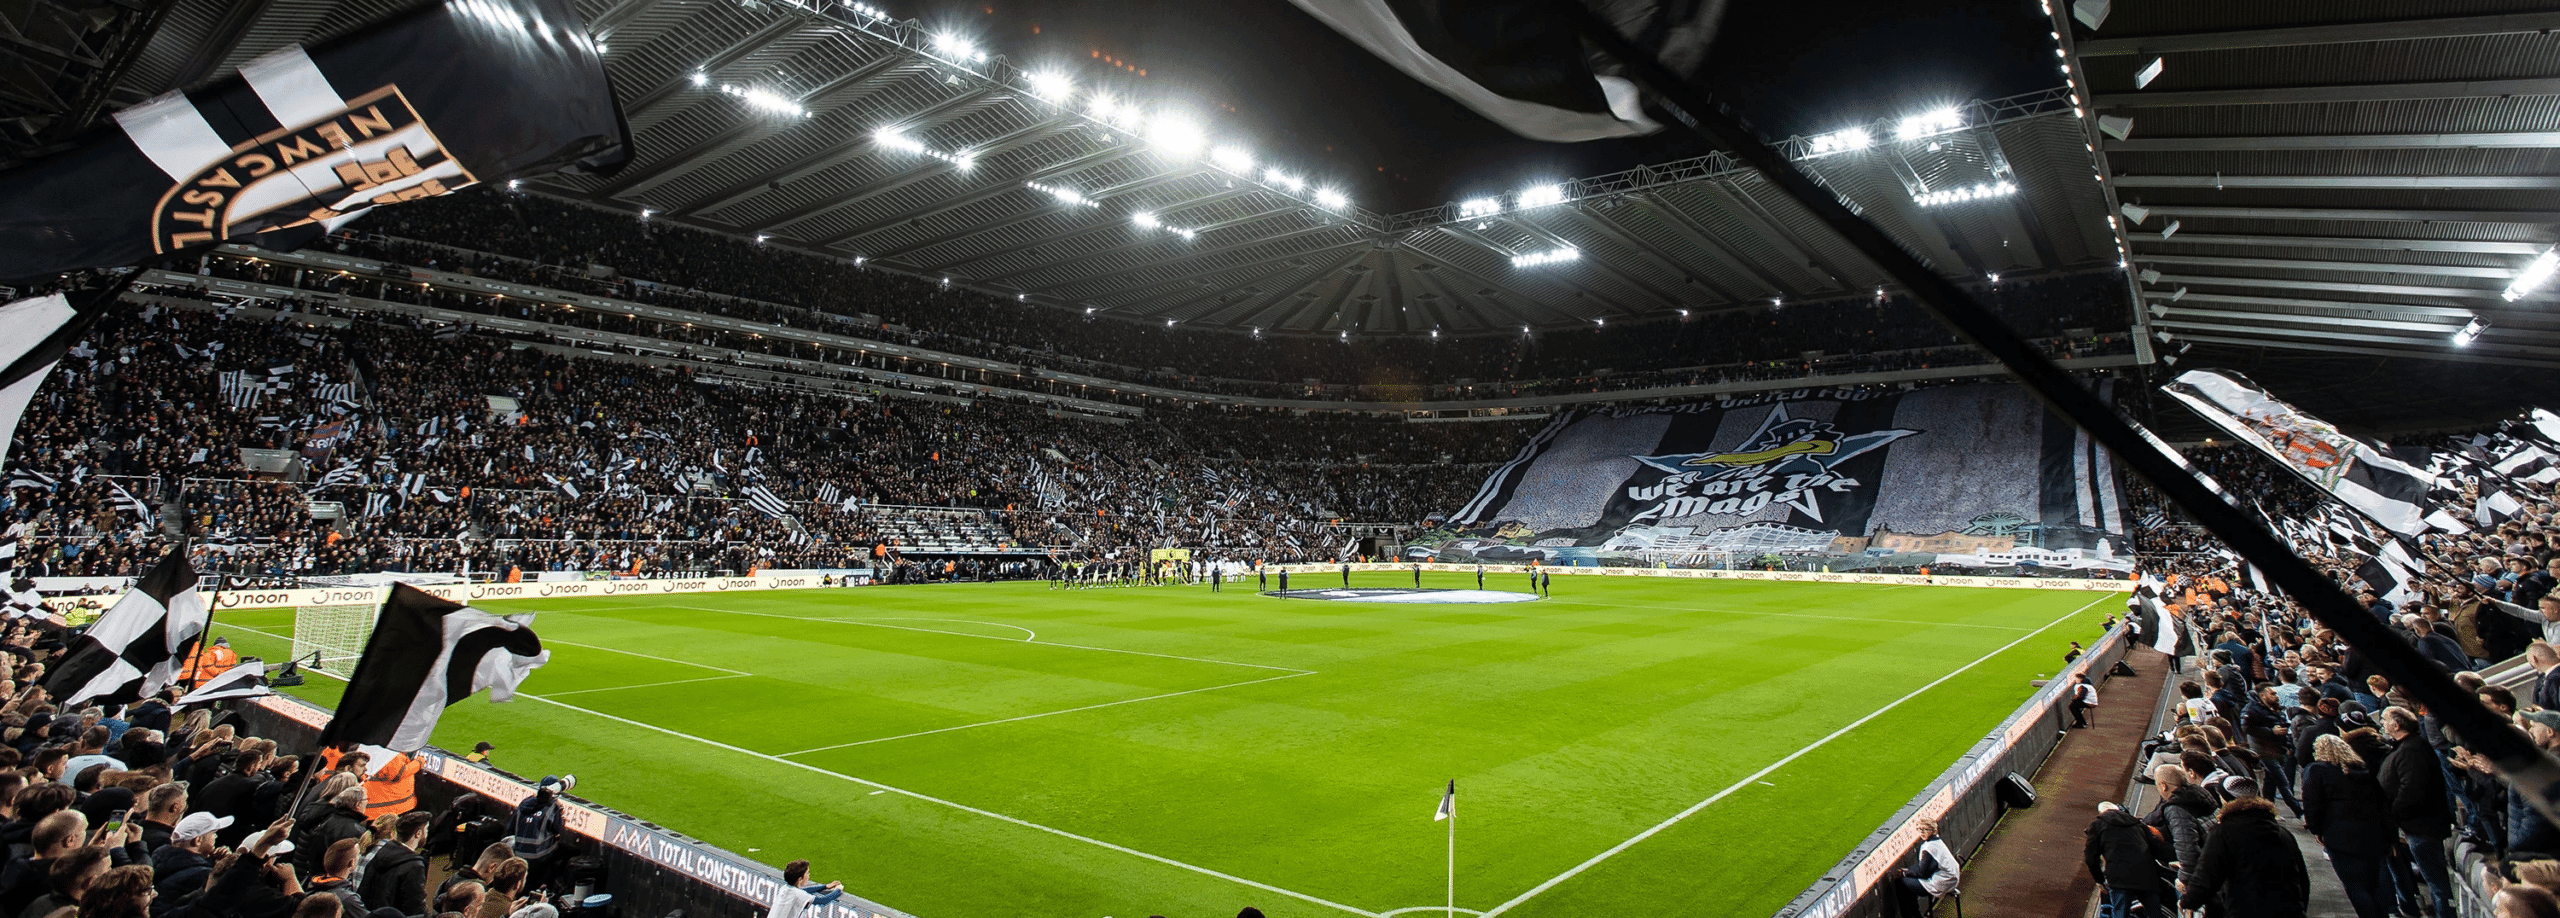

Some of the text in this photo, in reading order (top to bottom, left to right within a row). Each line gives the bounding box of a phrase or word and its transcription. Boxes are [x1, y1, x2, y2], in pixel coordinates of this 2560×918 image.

[1720, 388, 1811, 409] UNITED
[1702, 474, 1775, 496] are
[656, 571, 709, 579] CASTORE
[2096, 581, 2122, 589] noon
[243, 593, 289, 605] noon
[332, 590, 374, 603] noon
[487, 585, 523, 596] noon
[555, 584, 588, 593] noon
[618, 582, 648, 592] noon
[730, 579, 756, 588] noon
[780, 578, 805, 587] noon
[658, 840, 695, 874] TOTAL
